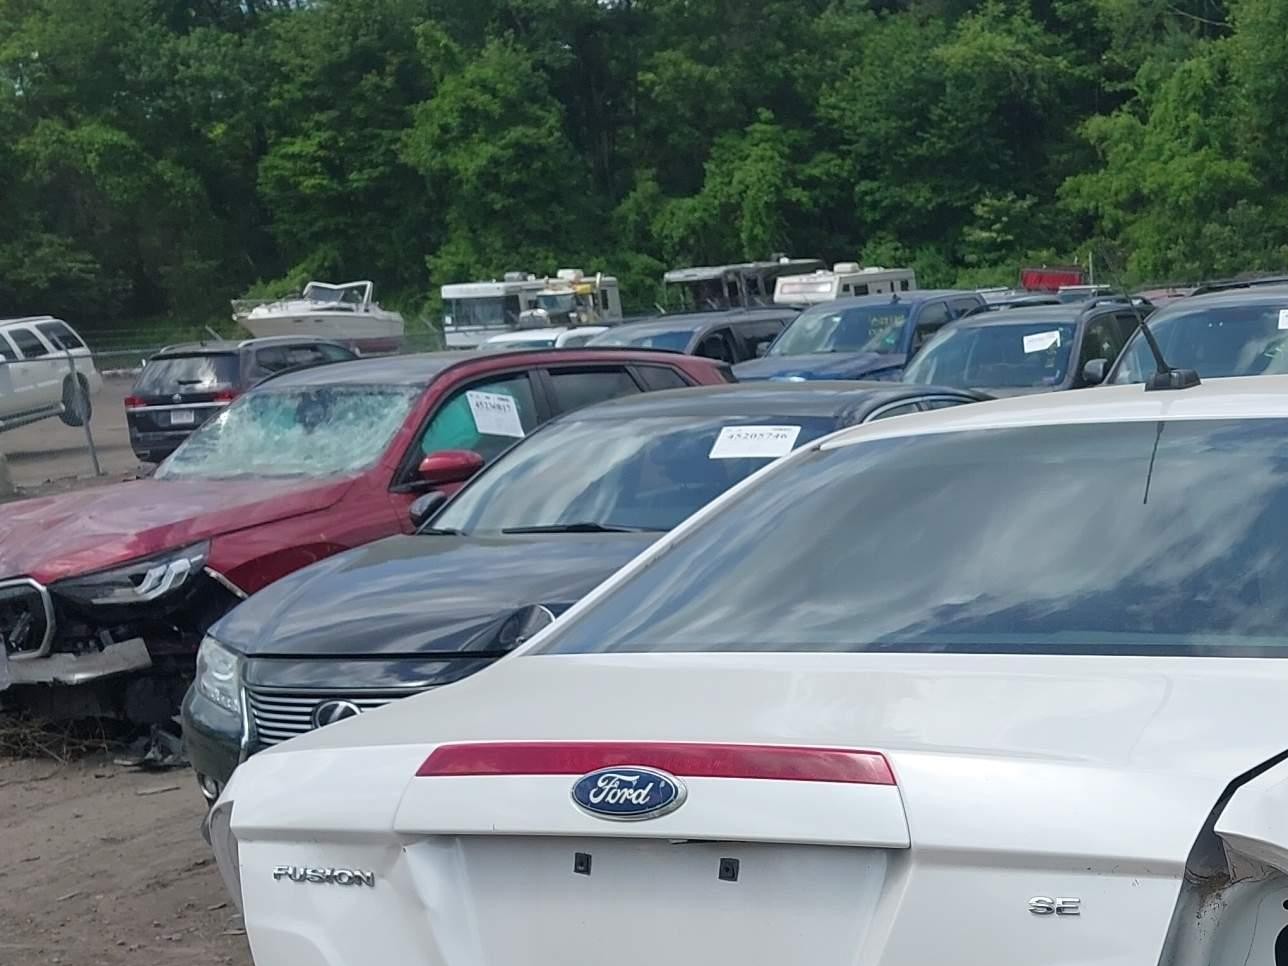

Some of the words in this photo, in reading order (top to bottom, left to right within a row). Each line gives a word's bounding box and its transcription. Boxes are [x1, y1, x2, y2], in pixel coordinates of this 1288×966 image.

[589, 773, 655, 804] Ford
[273, 864, 375, 888] FUSION
[1028, 895, 1081, 916] SE
